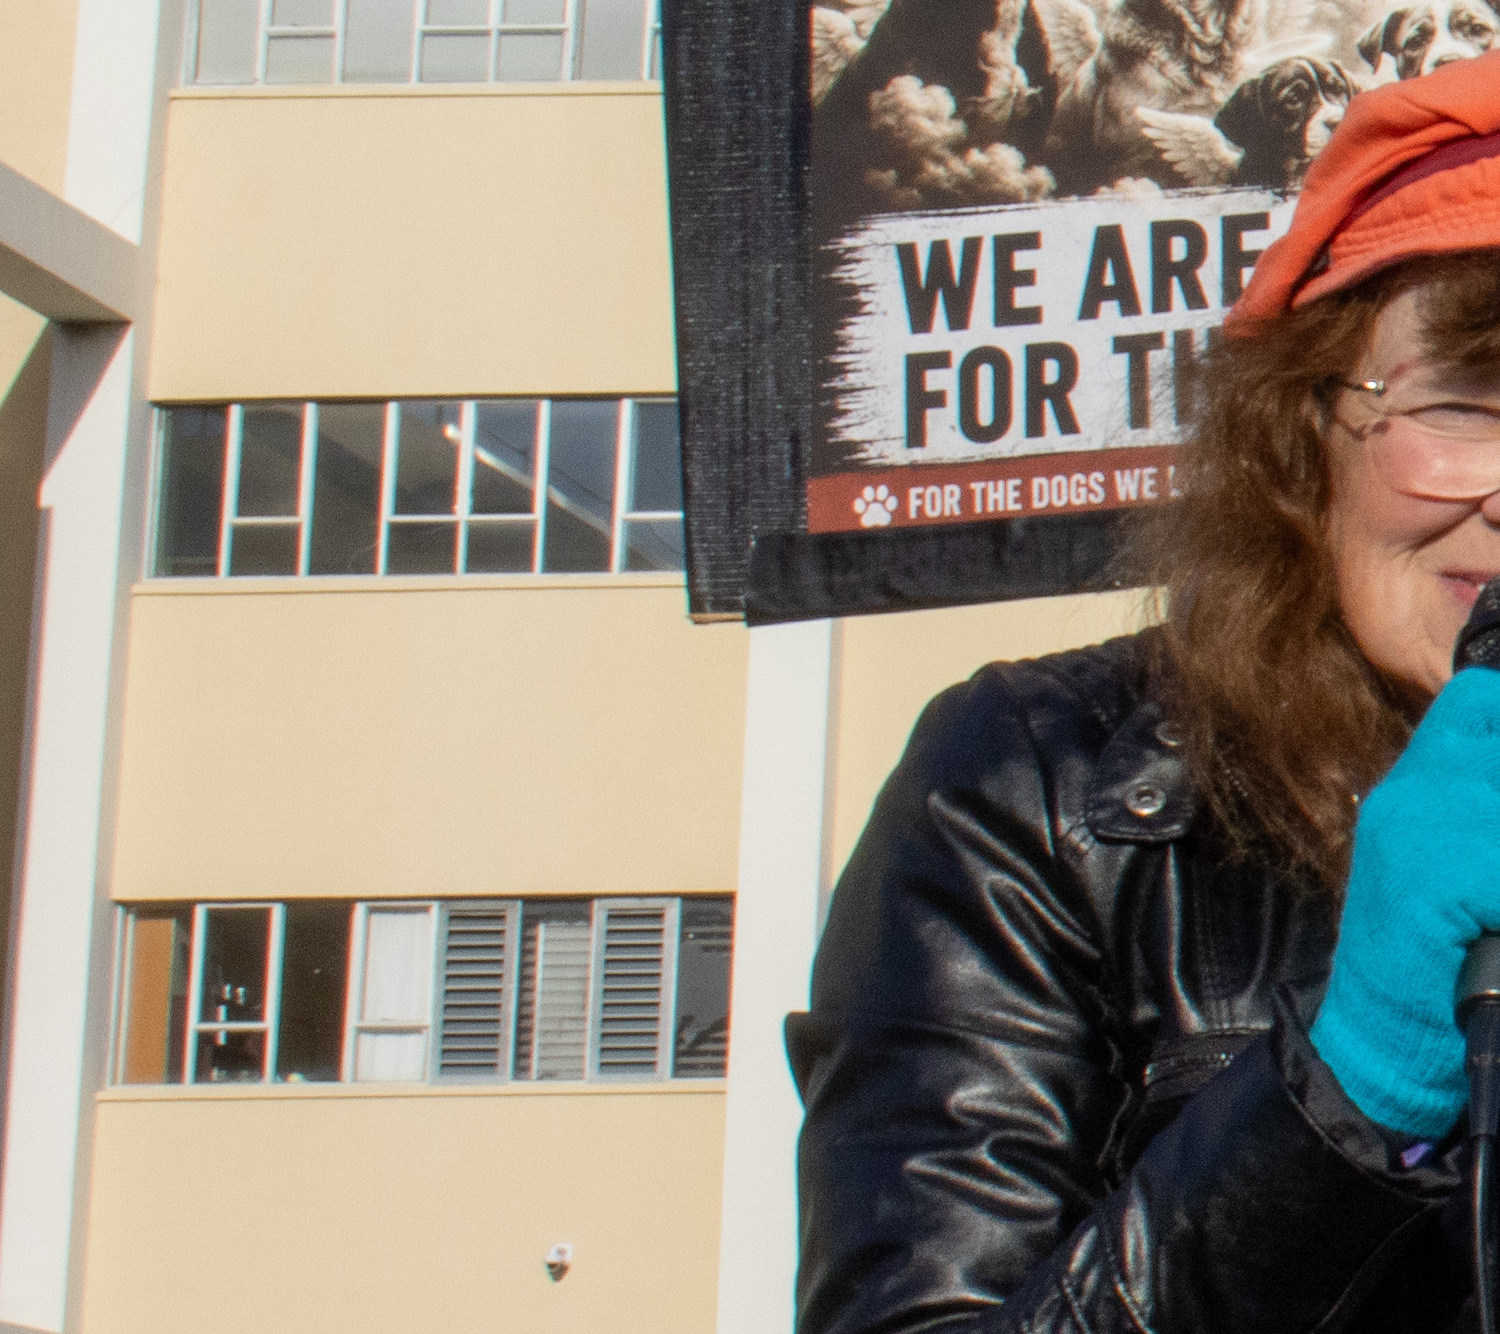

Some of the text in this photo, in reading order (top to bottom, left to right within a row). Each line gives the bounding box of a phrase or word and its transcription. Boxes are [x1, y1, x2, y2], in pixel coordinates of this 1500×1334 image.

[896, 231, 1042, 335] WE
[905, 341, 1081, 449] FOR
[908, 478, 961, 519] FOR
[970, 477, 1022, 514] THE
[1031, 470, 1105, 509] DOGS
[1114, 467, 1157, 502] WE
